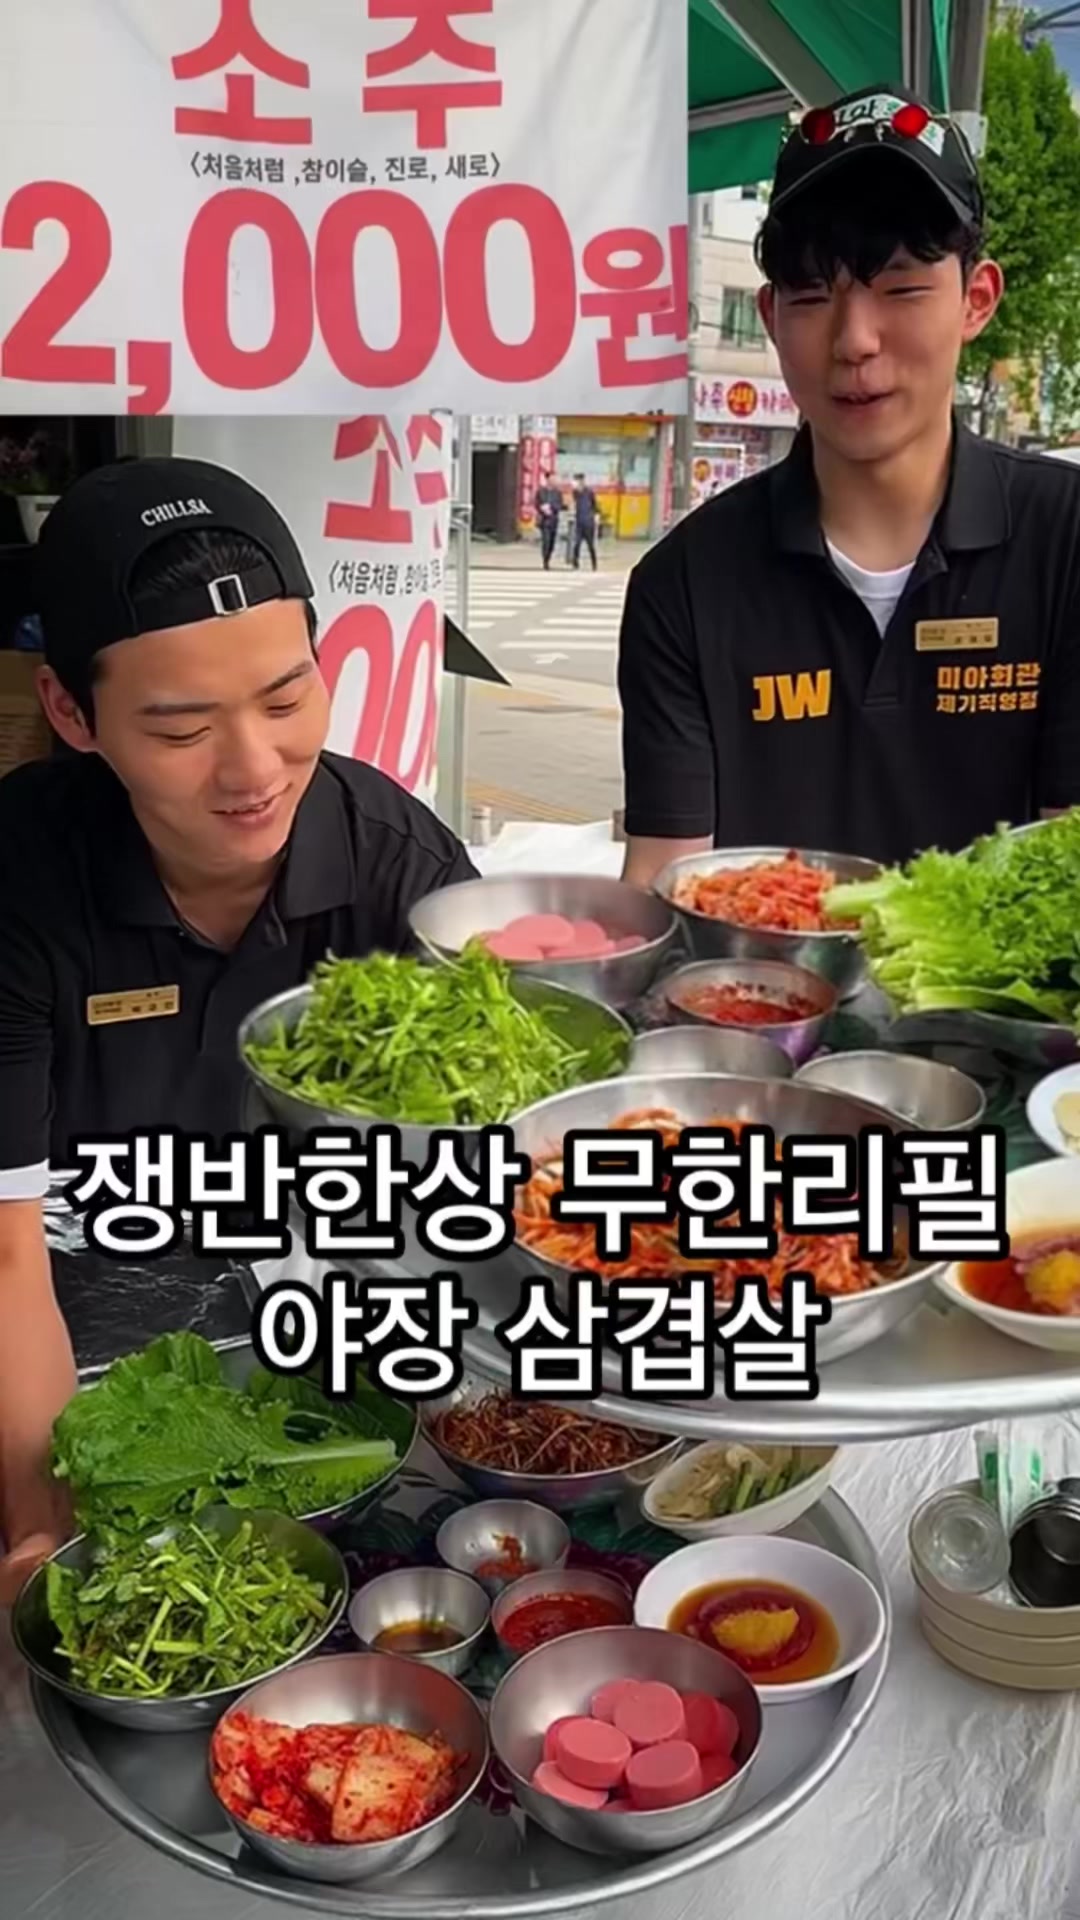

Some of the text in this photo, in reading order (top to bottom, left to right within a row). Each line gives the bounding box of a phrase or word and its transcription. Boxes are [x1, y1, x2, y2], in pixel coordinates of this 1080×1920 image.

[938, 663, 1041, 690] 미아회관
[752, 668, 831, 721] JW
[936, 691, 1038, 713] 제기직영점
